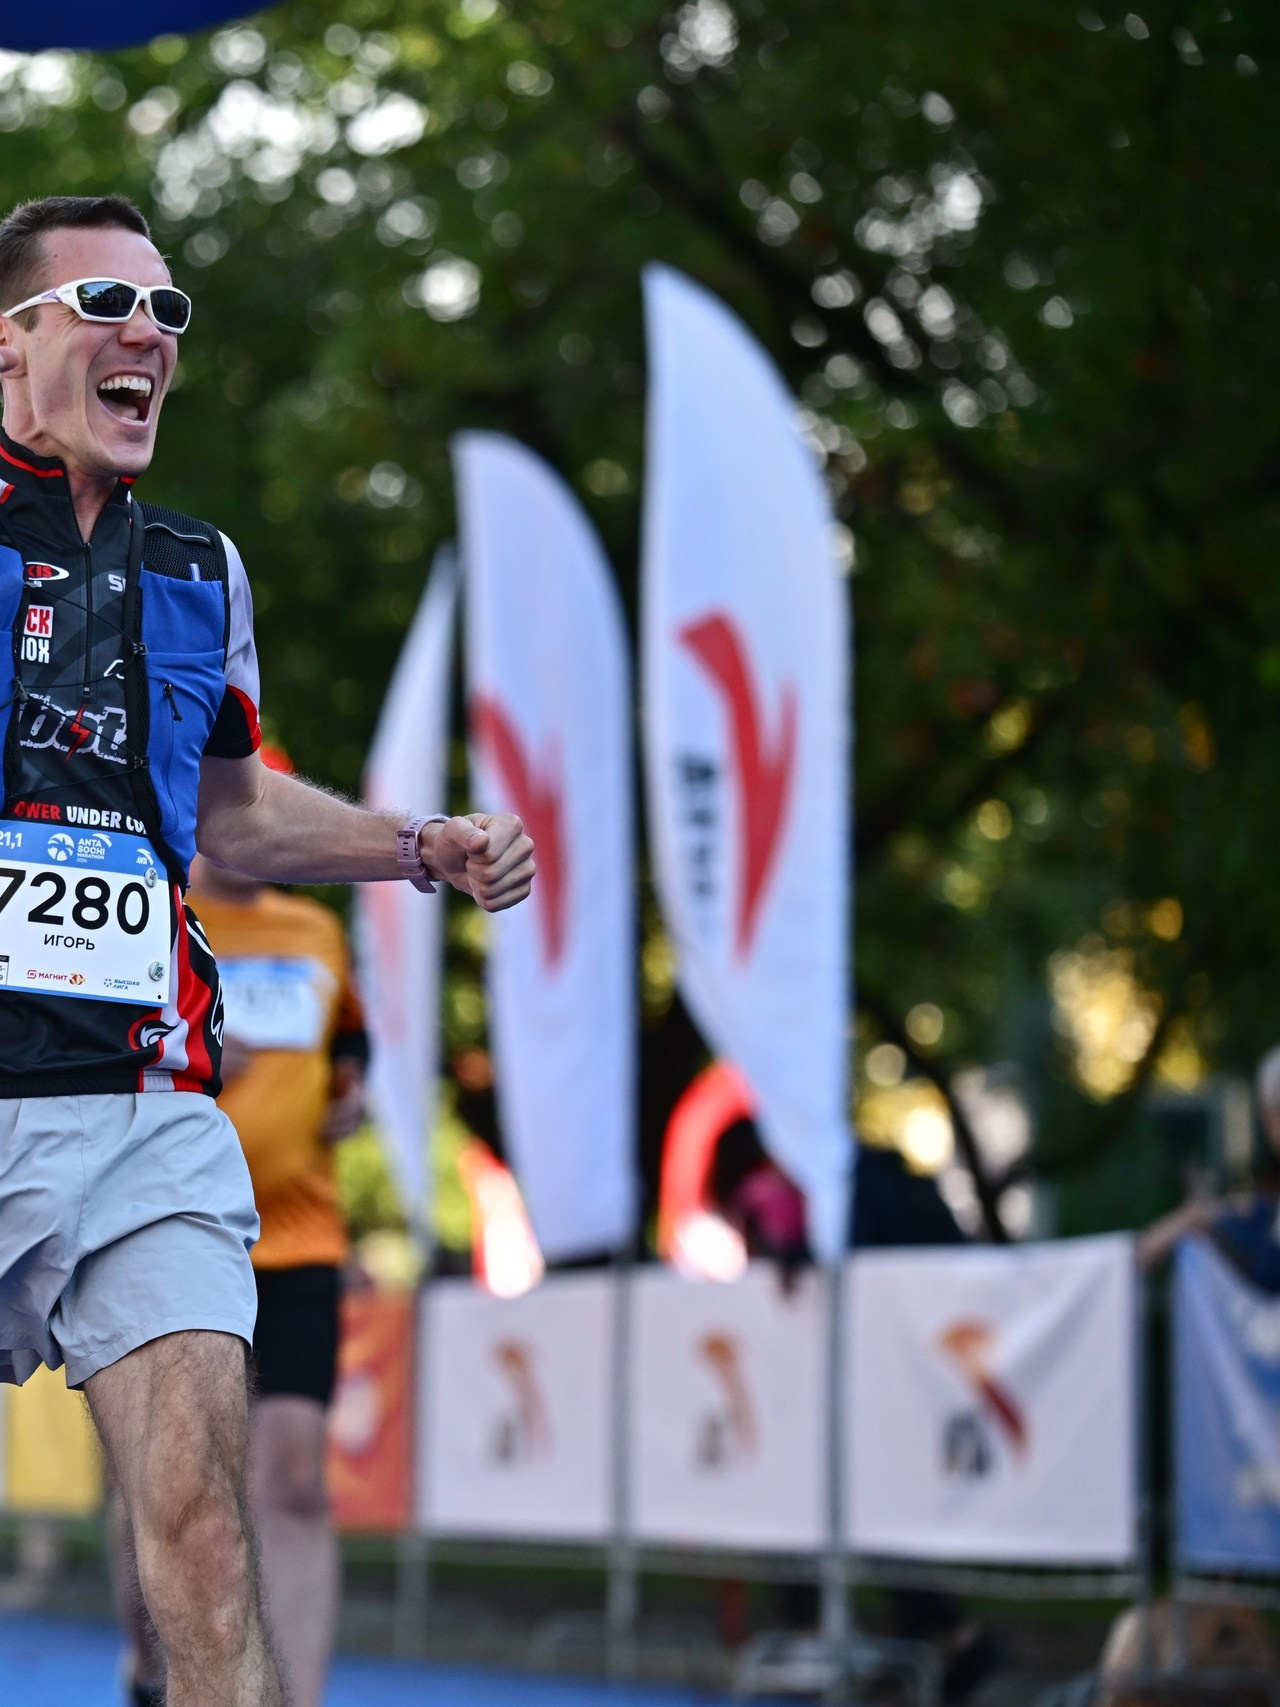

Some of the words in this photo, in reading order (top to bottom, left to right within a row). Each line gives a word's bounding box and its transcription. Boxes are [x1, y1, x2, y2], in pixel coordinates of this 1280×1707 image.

[14, 801, 61, 820] OWER
[66, 806, 122, 829] UNDER
[78, 838, 102, 848] ANTA
[77, 845, 106, 855] SOCHI
[76, 852, 104, 860] MARATHON
[44, 933, 95, 951] ИГОРЬ
[38, 972, 68, 981] МАГНИТ
[114, 979, 140, 987] ВЫСШАЯ
